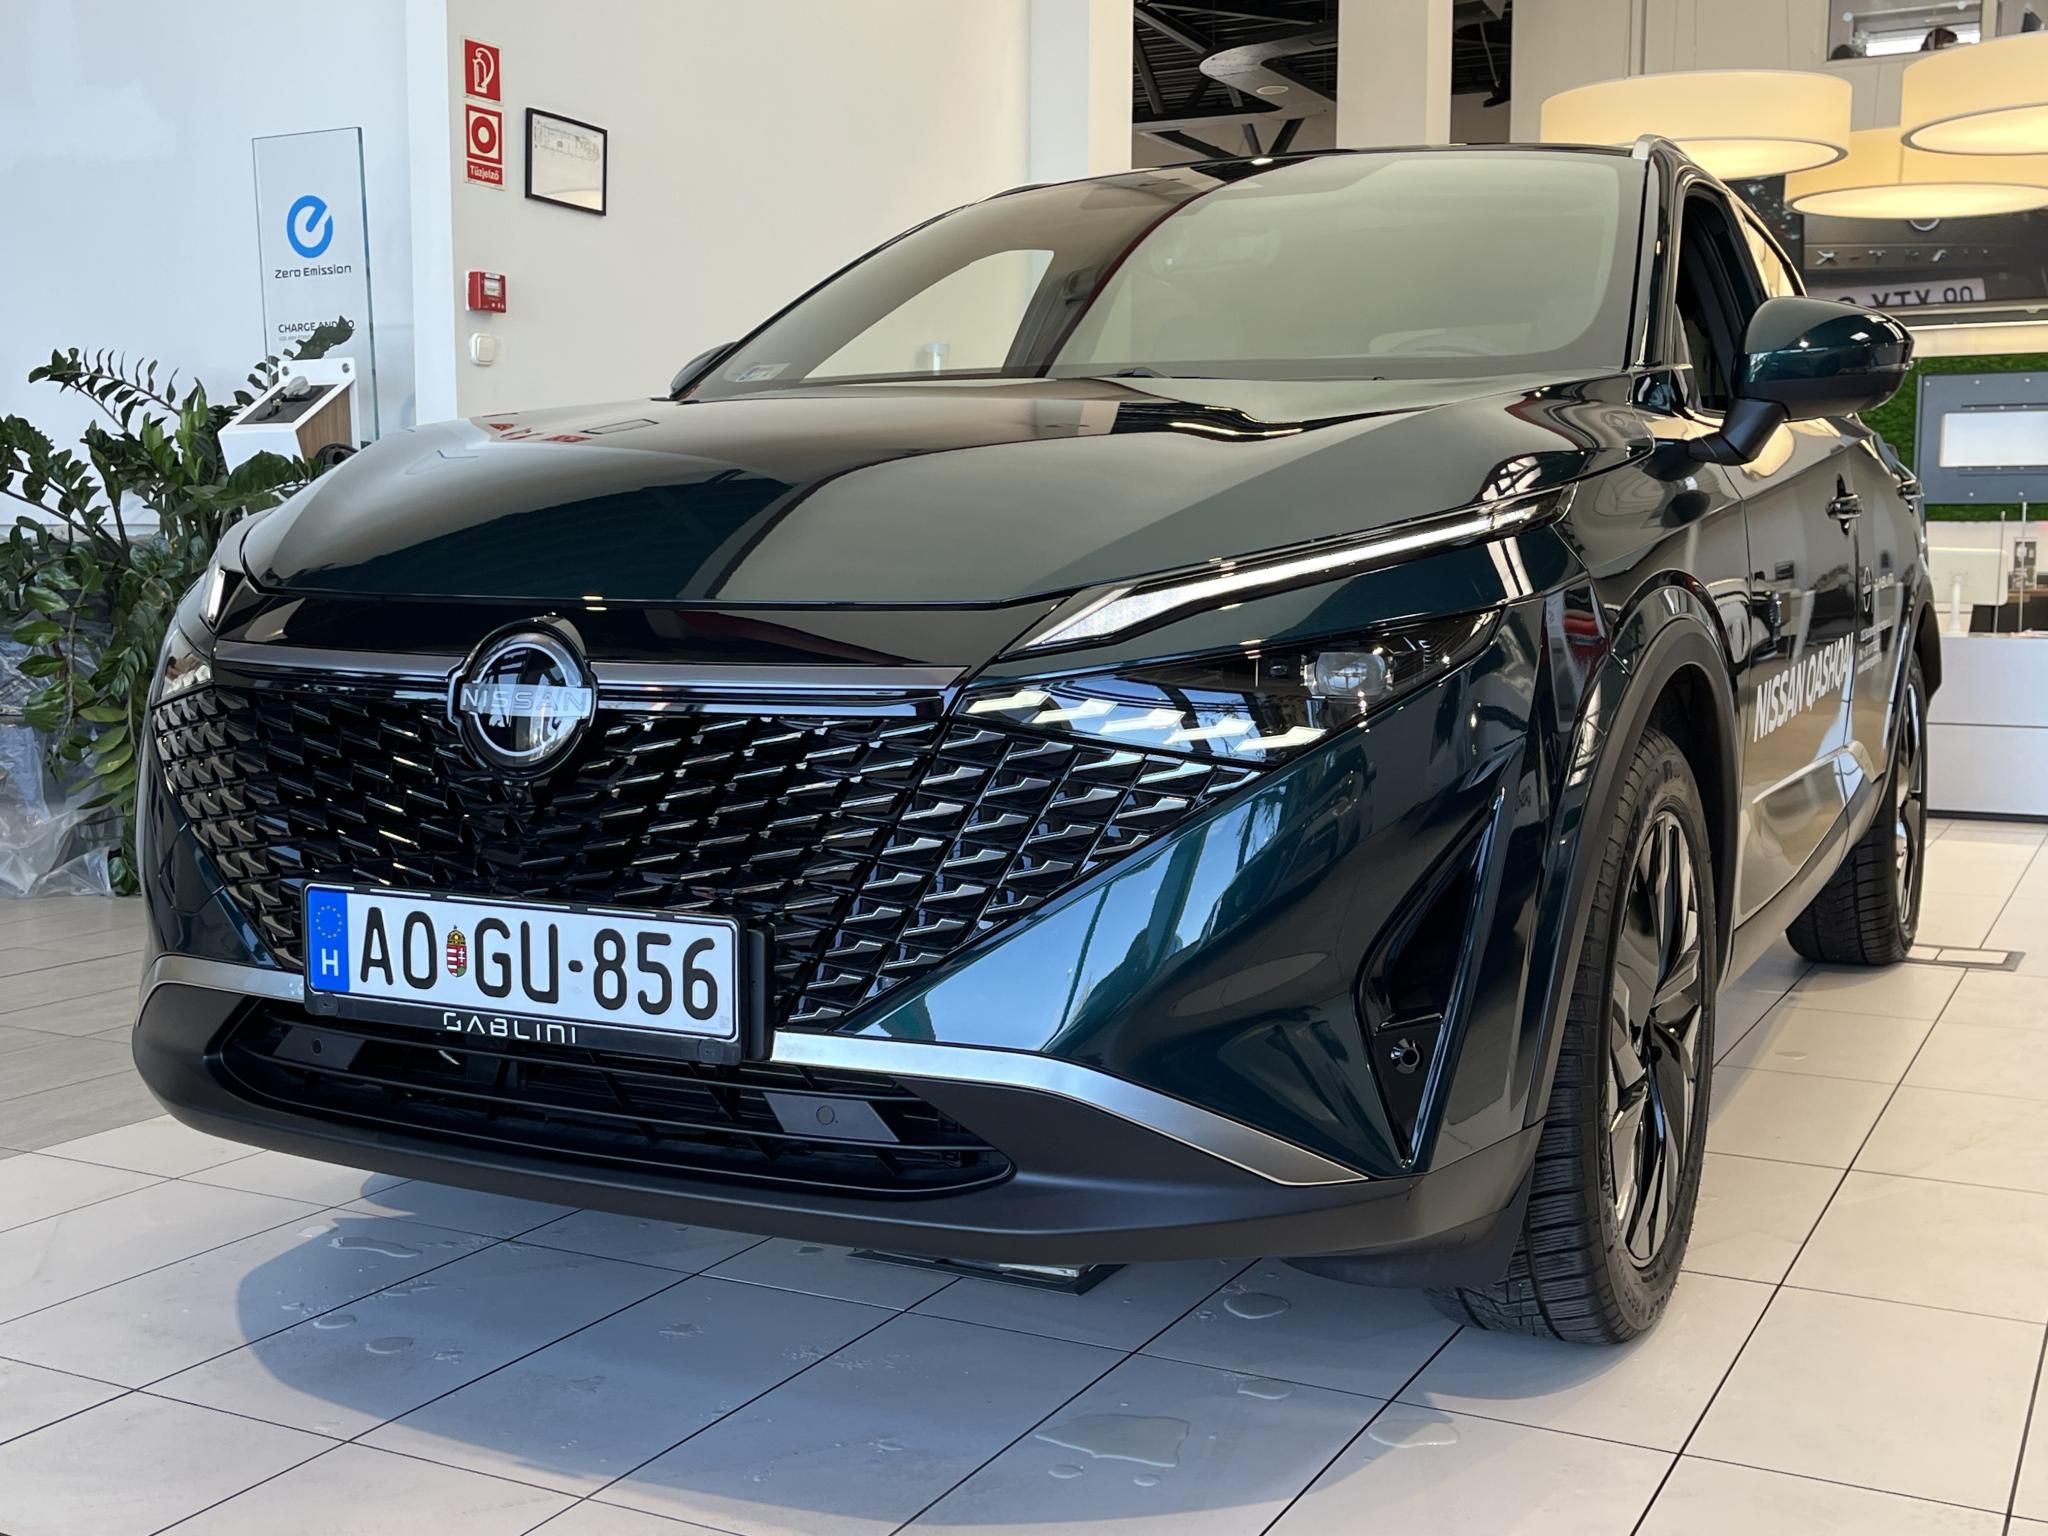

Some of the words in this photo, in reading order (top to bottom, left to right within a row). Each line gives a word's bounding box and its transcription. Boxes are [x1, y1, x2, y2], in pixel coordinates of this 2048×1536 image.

[275, 269, 301, 279] Zero
[303, 264, 352, 276] Emission
[278, 322, 316, 333] CHARGE
[462, 687, 588, 712] NISSAN
[1753, 659, 1807, 743] NISSAN
[1805, 631, 1854, 712] QASHQAI
[321, 948, 339, 977] H
[359, 906, 438, 990] AO
[442, 1011, 577, 1045] GABLINI
